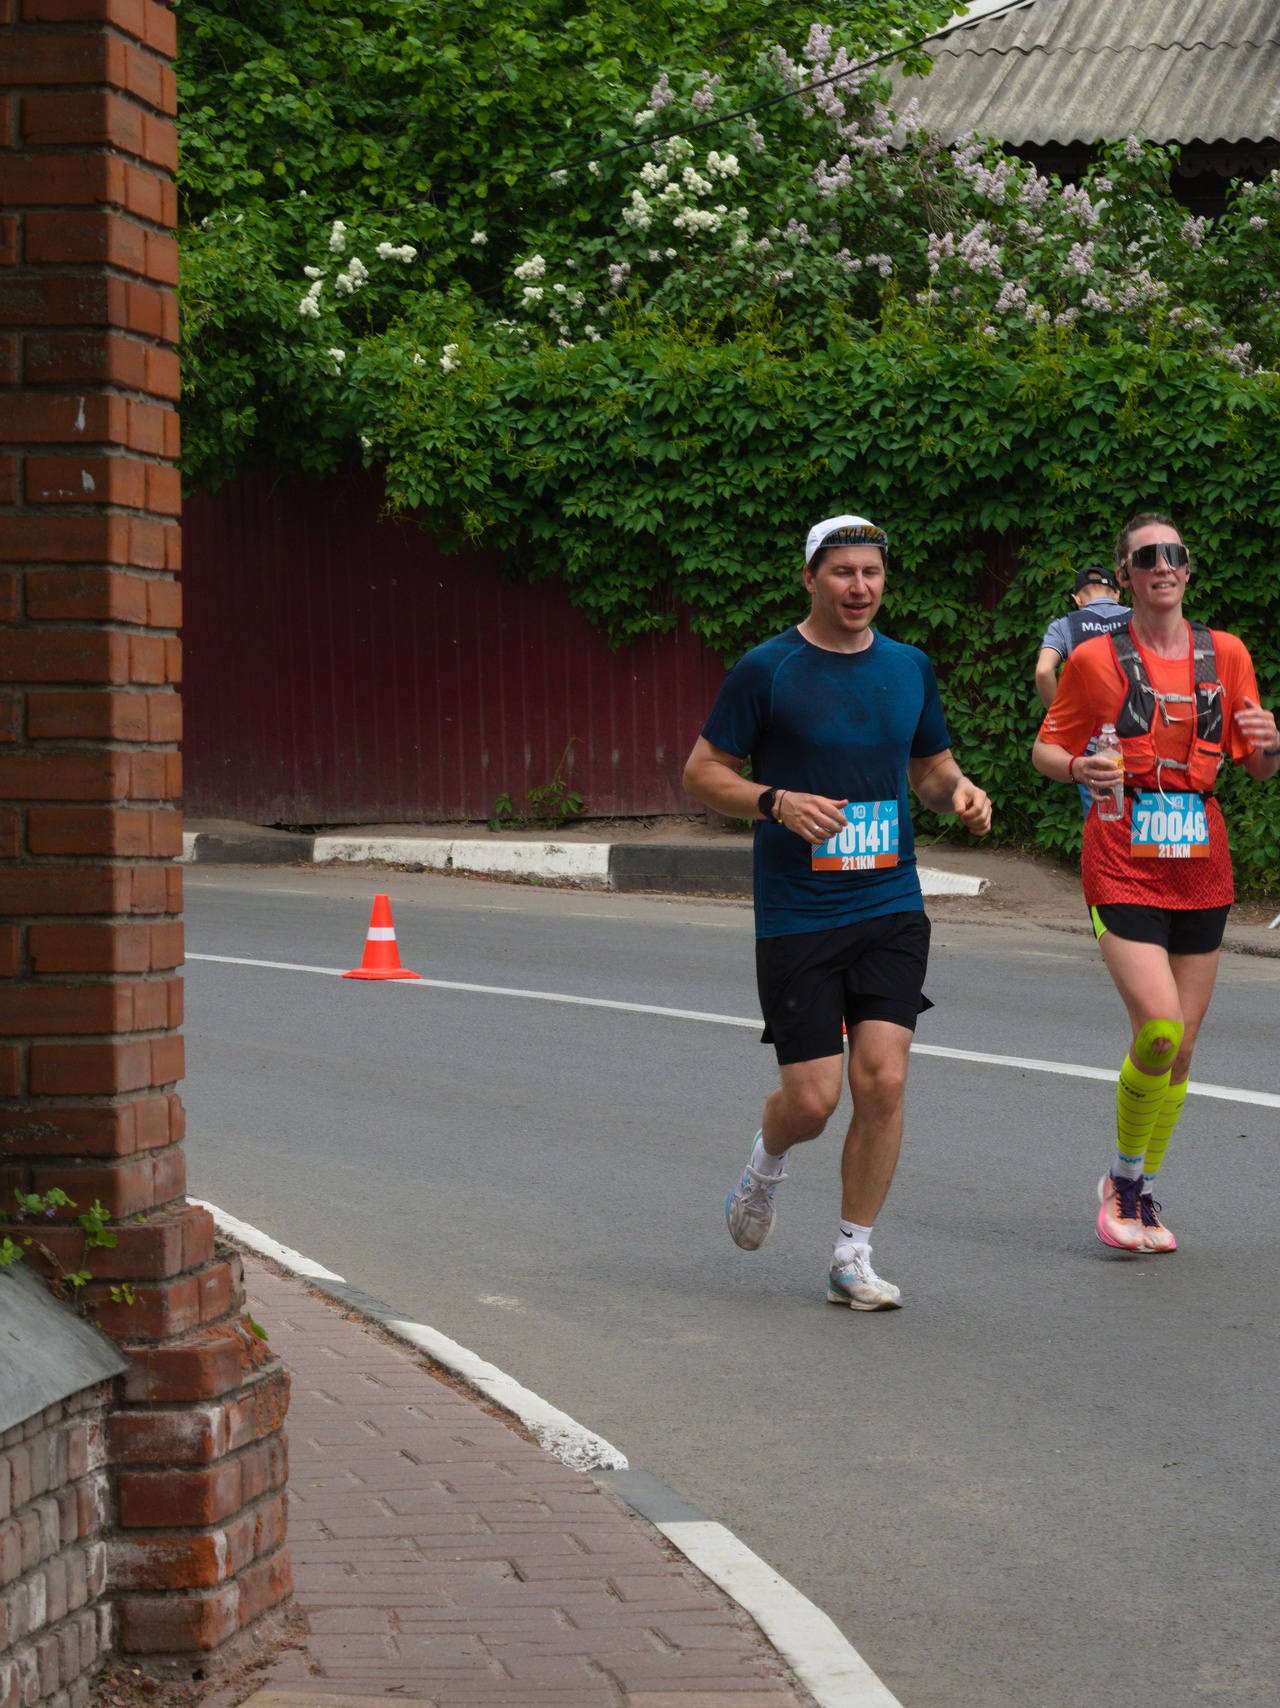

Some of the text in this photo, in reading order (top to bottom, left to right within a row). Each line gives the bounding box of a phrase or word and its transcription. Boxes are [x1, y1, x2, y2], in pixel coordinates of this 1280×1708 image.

[1137, 811, 1206, 842] 70046
[1158, 844, 1190, 858] 21.1KM
[842, 855, 875, 871] 21.1KM
